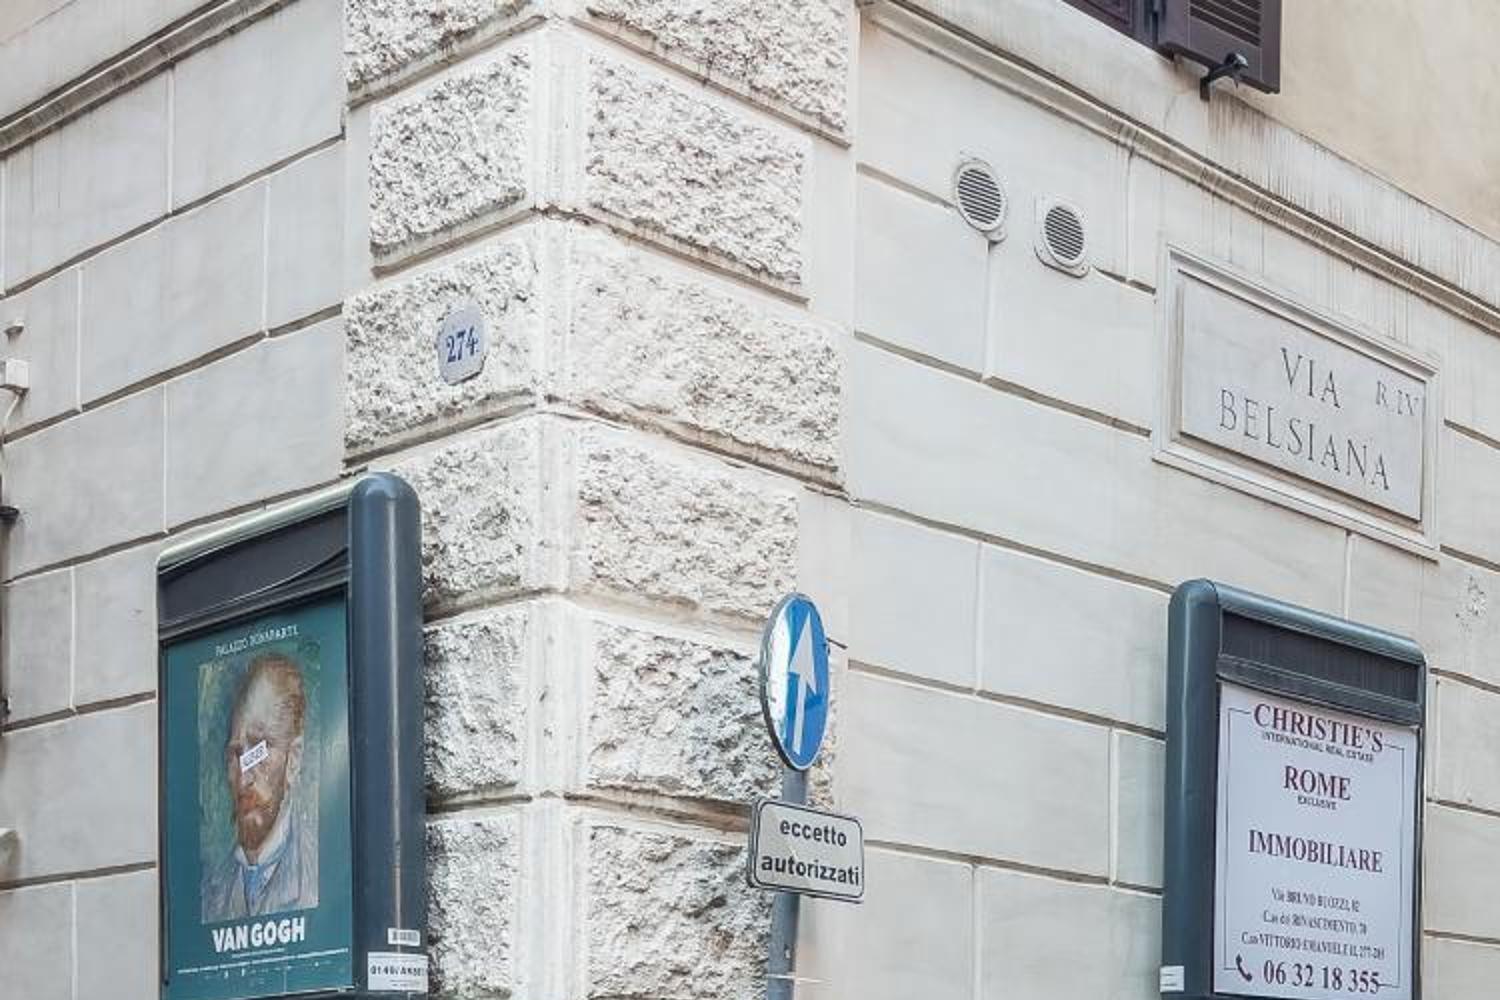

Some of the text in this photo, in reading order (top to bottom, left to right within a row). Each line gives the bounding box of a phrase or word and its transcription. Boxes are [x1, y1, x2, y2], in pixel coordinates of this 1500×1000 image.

[1281, 347, 1340, 409] VIA
[1219, 388, 1389, 491] BELSIANA
[1254, 703, 1383, 753] CHRISTIE'S
[1262, 731, 1324, 753] INTERNATIONAL
[1326, 745, 1345, 758] REAL
[1283, 765, 1351, 801] ROME
[780, 819, 847, 847] eccetto
[1249, 829, 1383, 874] IMMOBILIARE
[761, 855, 859, 886] autorizzati
[211, 916, 305, 953] VAN GOGH
[1264, 960, 1379, 994] 06 32 18 355
